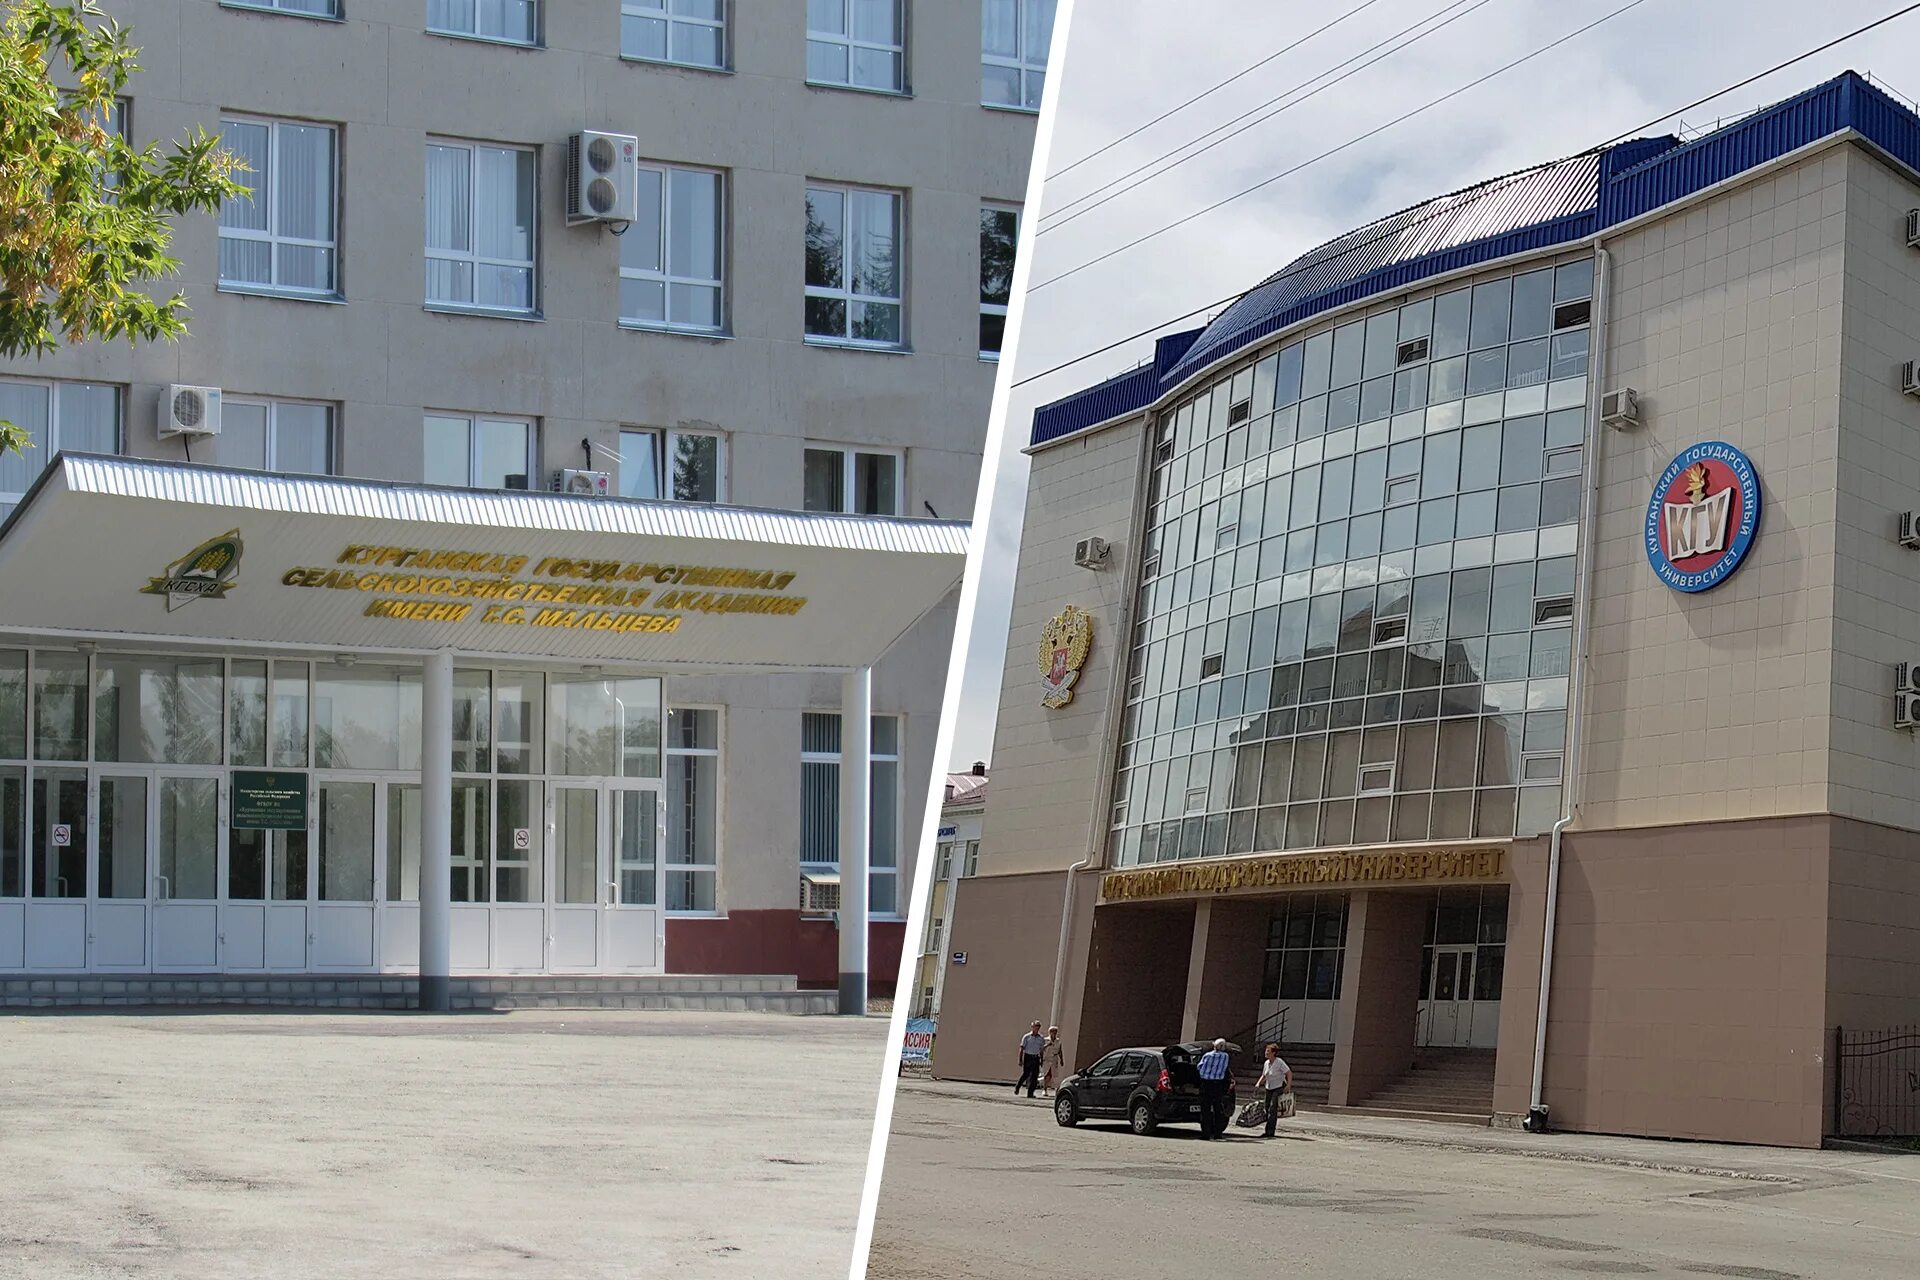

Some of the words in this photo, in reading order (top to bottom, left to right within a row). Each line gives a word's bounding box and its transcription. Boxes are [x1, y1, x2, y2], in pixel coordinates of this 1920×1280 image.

[1648, 463, 1681, 554] КУРГАНСКИЙ
[1686, 445, 1753, 536] ГОСУДАРСТВЕННЫЙ
[1669, 496, 1728, 556] КГУ
[163, 580, 219, 593] КГСХА
[281, 566, 652, 607] СЕЛЬСКОХОЗЯЙСТВЕННАЯ
[336, 544, 529, 575] КУРГАНСКАЯ
[532, 556, 797, 590] ГОСУДАРСТВЕННАЯ
[1660, 547, 1738, 587] УНИВЕРСИТЕТ
[363, 599, 473, 623] ИМЕНИ
[531, 607, 682, 634] МАЛЬЦЕВА
[1350, 849, 1505, 881] УНИВЕРСИТЕТ
